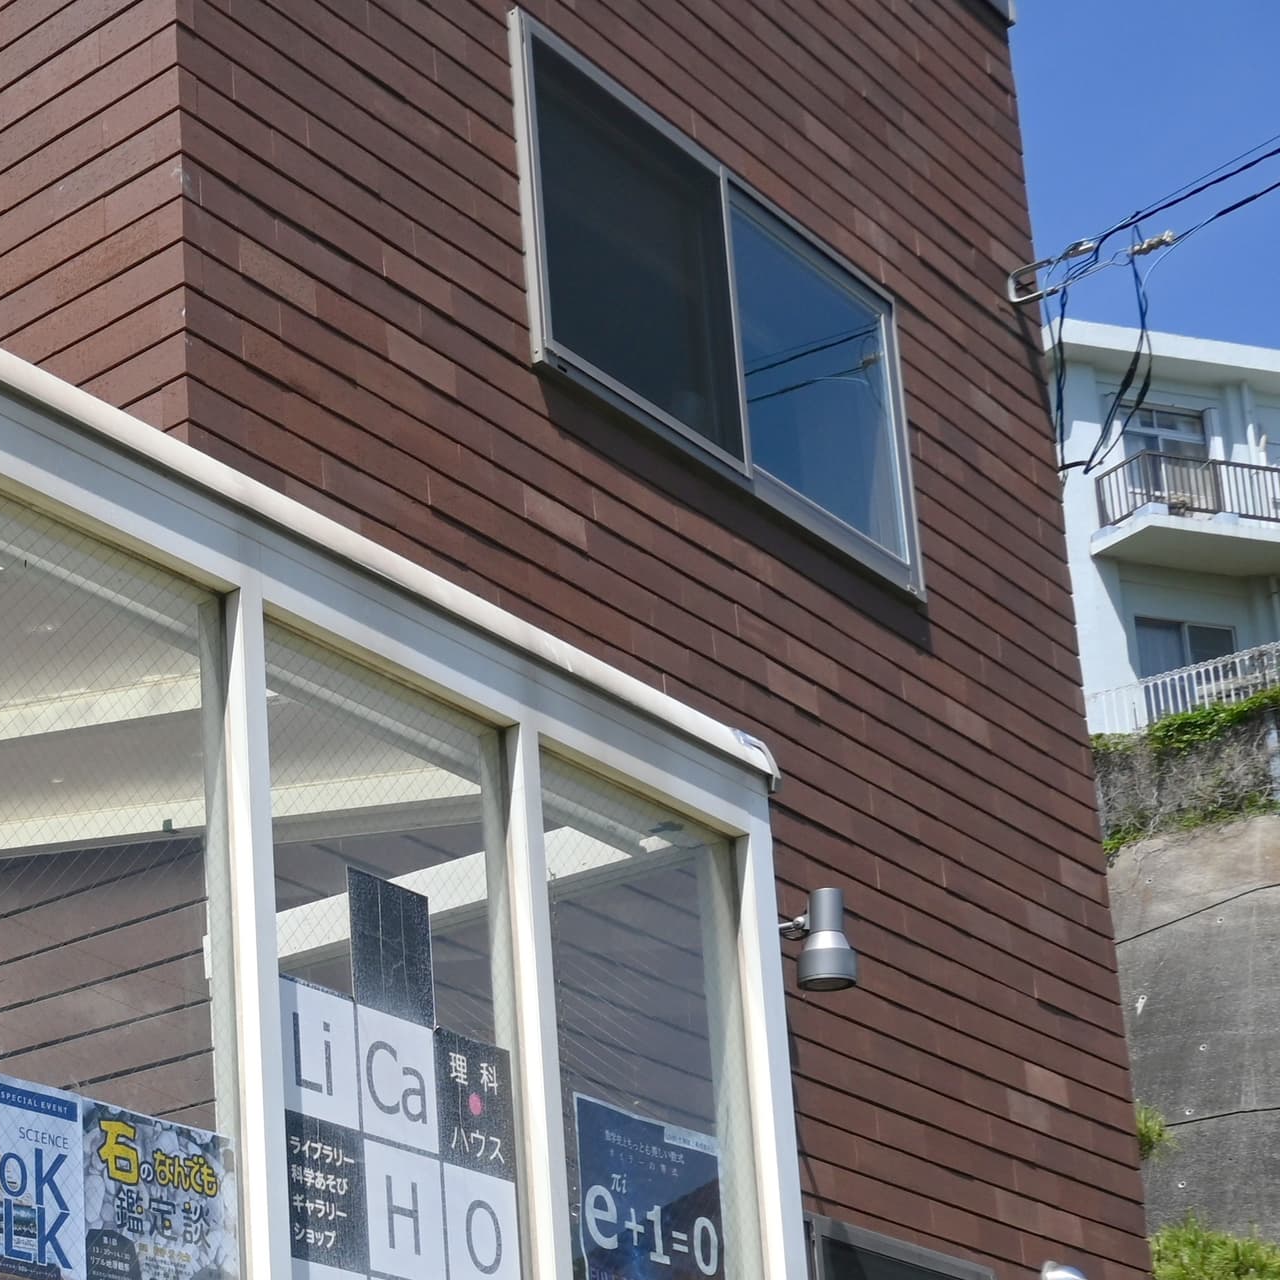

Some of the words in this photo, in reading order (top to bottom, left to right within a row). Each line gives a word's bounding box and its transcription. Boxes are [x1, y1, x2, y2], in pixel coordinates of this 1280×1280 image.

[292, 1011, 334, 1097] Li
[365, 1039, 429, 1125] Ca
[1, 1091, 38, 1107] SPECIAL
[40, 1101, 68, 1114] EVENT
[19, 1127, 69, 1149] SCIENCE
[451, 1126, 505, 1165] ハウス
[290, 1162, 349, 1194] 科学あそび
[292, 1194, 348, 1221] ギャラリー
[294, 1221, 337, 1250] ショップ
[385, 1173, 422, 1256] H
[465, 1199, 503, 1276] O
